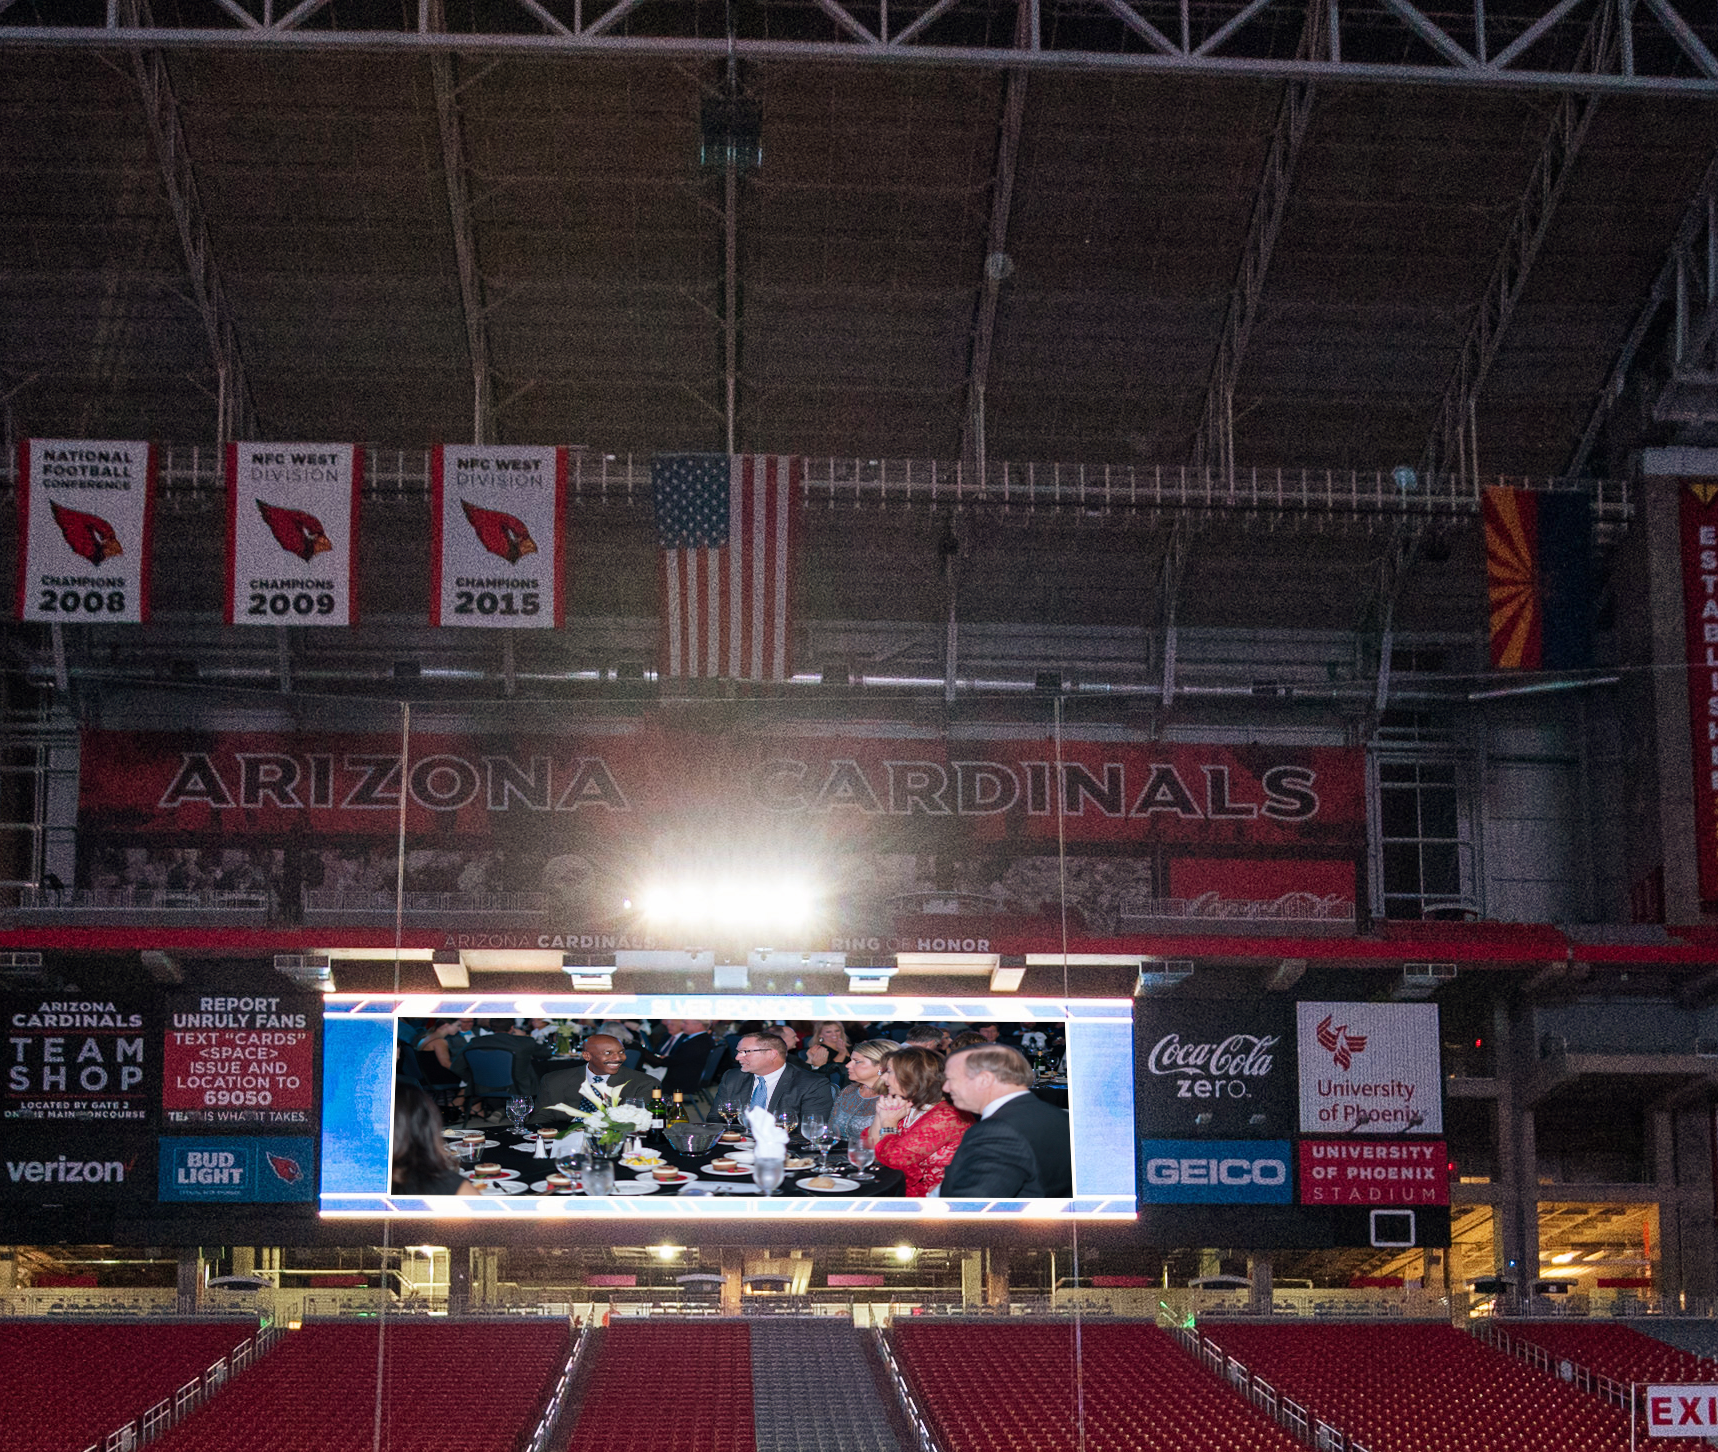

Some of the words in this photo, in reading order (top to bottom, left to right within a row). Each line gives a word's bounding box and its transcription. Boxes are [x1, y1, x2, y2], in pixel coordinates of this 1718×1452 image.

[44, 450, 133, 463] NATIONAL
[252, 453, 285, 466] NFC
[291, 453, 338, 466] WEST
[43, 464, 132, 478] FOOTBALL
[457, 458, 490, 471] NFC
[496, 458, 542, 471] WEST
[251, 469, 339, 483] DIVISION
[456, 473, 543, 487] DIVISION
[42, 479, 131, 491] CONFERENCE
[41, 575, 125, 588] CHAMPIONS
[250, 580, 335, 591] CHAMPIONS
[455, 577, 539, 590] CHAMPIONS
[39, 591, 126, 613] 2008
[247, 594, 335, 615] 2009
[454, 592, 540, 615] 2015
[158, 753, 632, 811] ARIZONA
[760, 759, 1320, 821] CARDINALS
[444, 934, 530, 948] ARIZONA
[537, 934, 656, 949] CARDINALS
[833, 938, 880, 951] RING
[917, 938, 990, 951] HONOR
[38, 1001, 117, 1013] ARIZONA
[200, 997, 280, 1011] REPORT
[651, 999, 712, 1016] SILVER
[715, 999, 813, 1016] SPONSORS
[12, 1013, 143, 1028] CARDINALS
[173, 1013, 250, 1028] UNRULY
[255, 1014, 307, 1028] FANS
[173, 1032, 219, 1045] TEXT
[9, 1037, 144, 1063] TEAM
[199, 1047, 279, 1059] <SPACE>
[1147, 1033, 1281, 1076] Coca-Cola
[190, 1061, 241, 1074] ISSUE
[247, 1061, 288, 1074] AND
[9, 1065, 143, 1091] SHOP
[177, 1076, 270, 1089] LOCATION
[277, 1076, 300, 1089] TO
[204, 1090, 273, 1105] 69050
[1317, 1079, 1415, 1102] University
[20, 1102, 70, 1110] LOCATED
[74, 1102, 87, 1110] BY
[91, 1102, 119, 1110] GATE
[47, 1111, 75, 1119] MAIN
[1319, 1104, 1339, 1121] of
[1345, 1104, 1420, 1123] Phoenix
[187, 1152, 234, 1168] BUD
[1312, 1146, 1433, 1160] UNIVERSITY
[6, 1155, 124, 1182] verizon
[1146, 1158, 1286, 1186] GEICO
[1312, 1166, 1338, 1180] OF
[1346, 1166, 1435, 1180] PHOENIX
[178, 1168, 243, 1185] LIGHT
[1313, 1187, 1435, 1201] STADIUM
